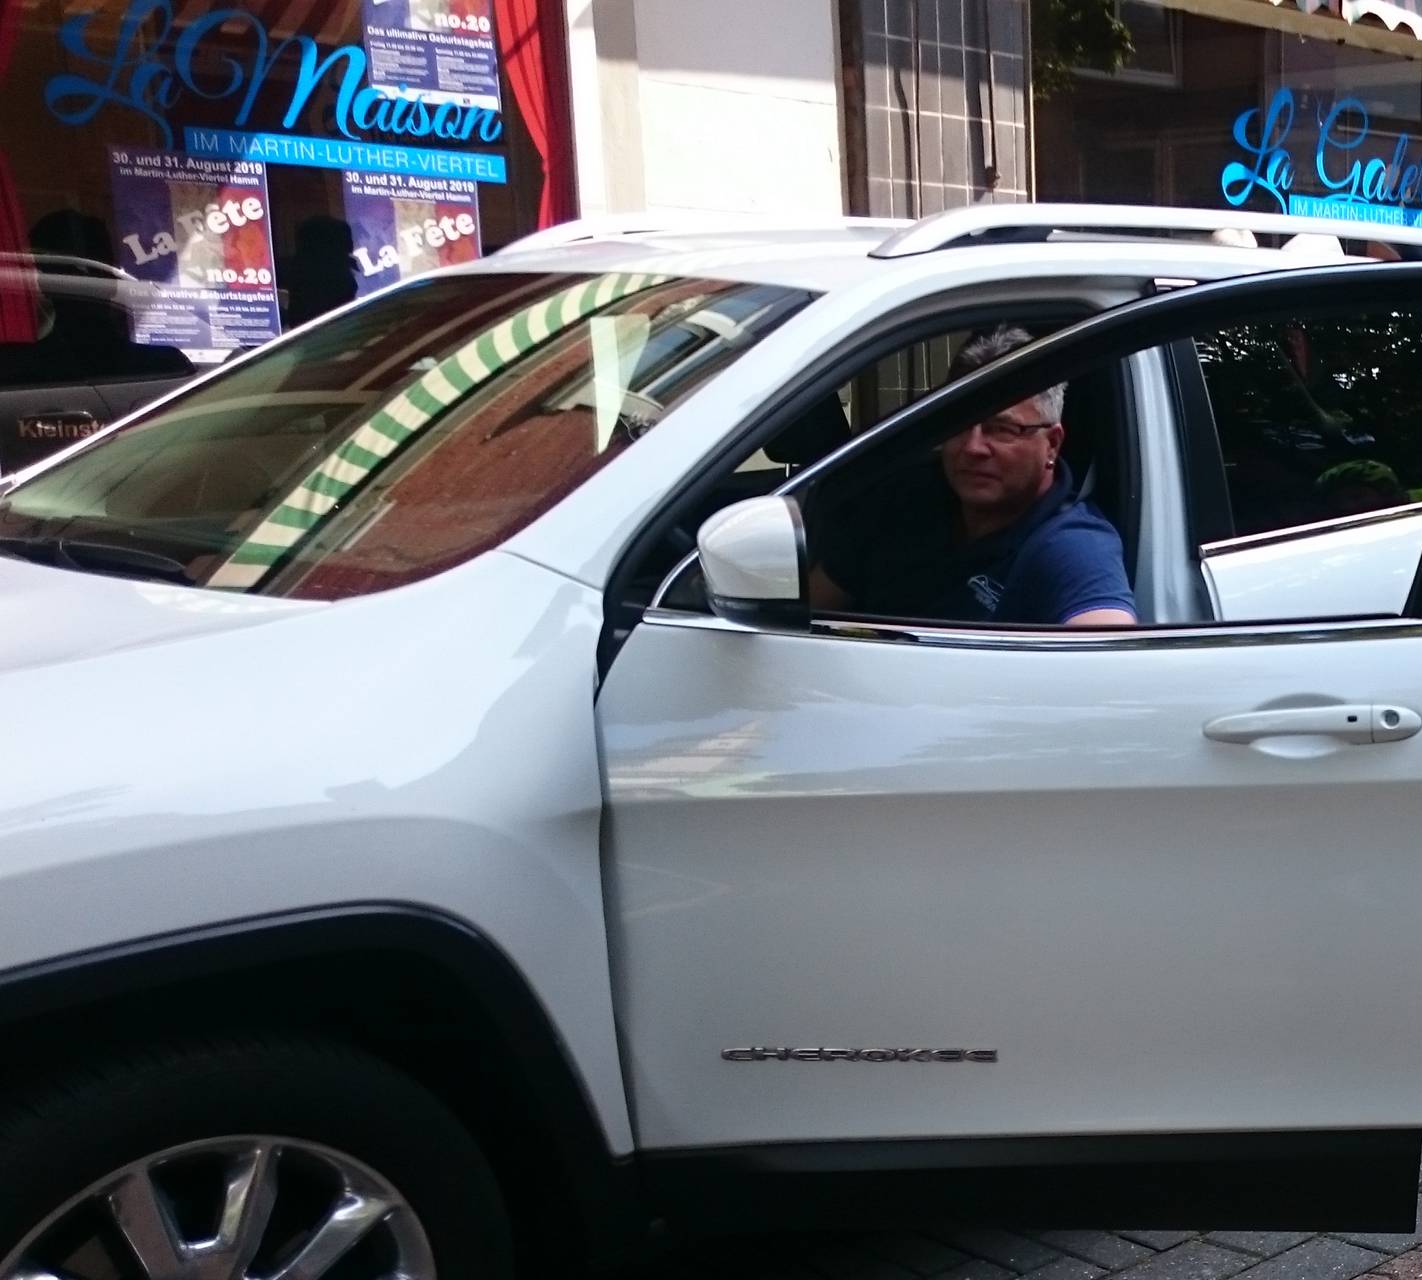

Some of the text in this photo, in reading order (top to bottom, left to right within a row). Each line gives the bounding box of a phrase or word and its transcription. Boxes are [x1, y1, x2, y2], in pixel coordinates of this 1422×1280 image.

[434, 12, 491, 33] no.20
[45, 0, 505, 151] La Maison
[193, 131, 499, 178] IM MARTIN-LUTHER-VIERTEL
[1221, 86, 1295, 214] La
[112, 152, 264, 176] 30. und 31. August 2019
[134, 168, 228, 184] Martin-Luther-Viertel
[230, 176, 260, 187] Hamm
[345, 172, 474, 193] 30. und 31. August 2019
[1294, 199, 1309, 216] IM
[123, 197, 264, 266] La Fête
[353, 213, 475, 276] La Fête
[206, 268, 272, 285] no.20
[721, 1048, 998, 1063] CHEROKEE
